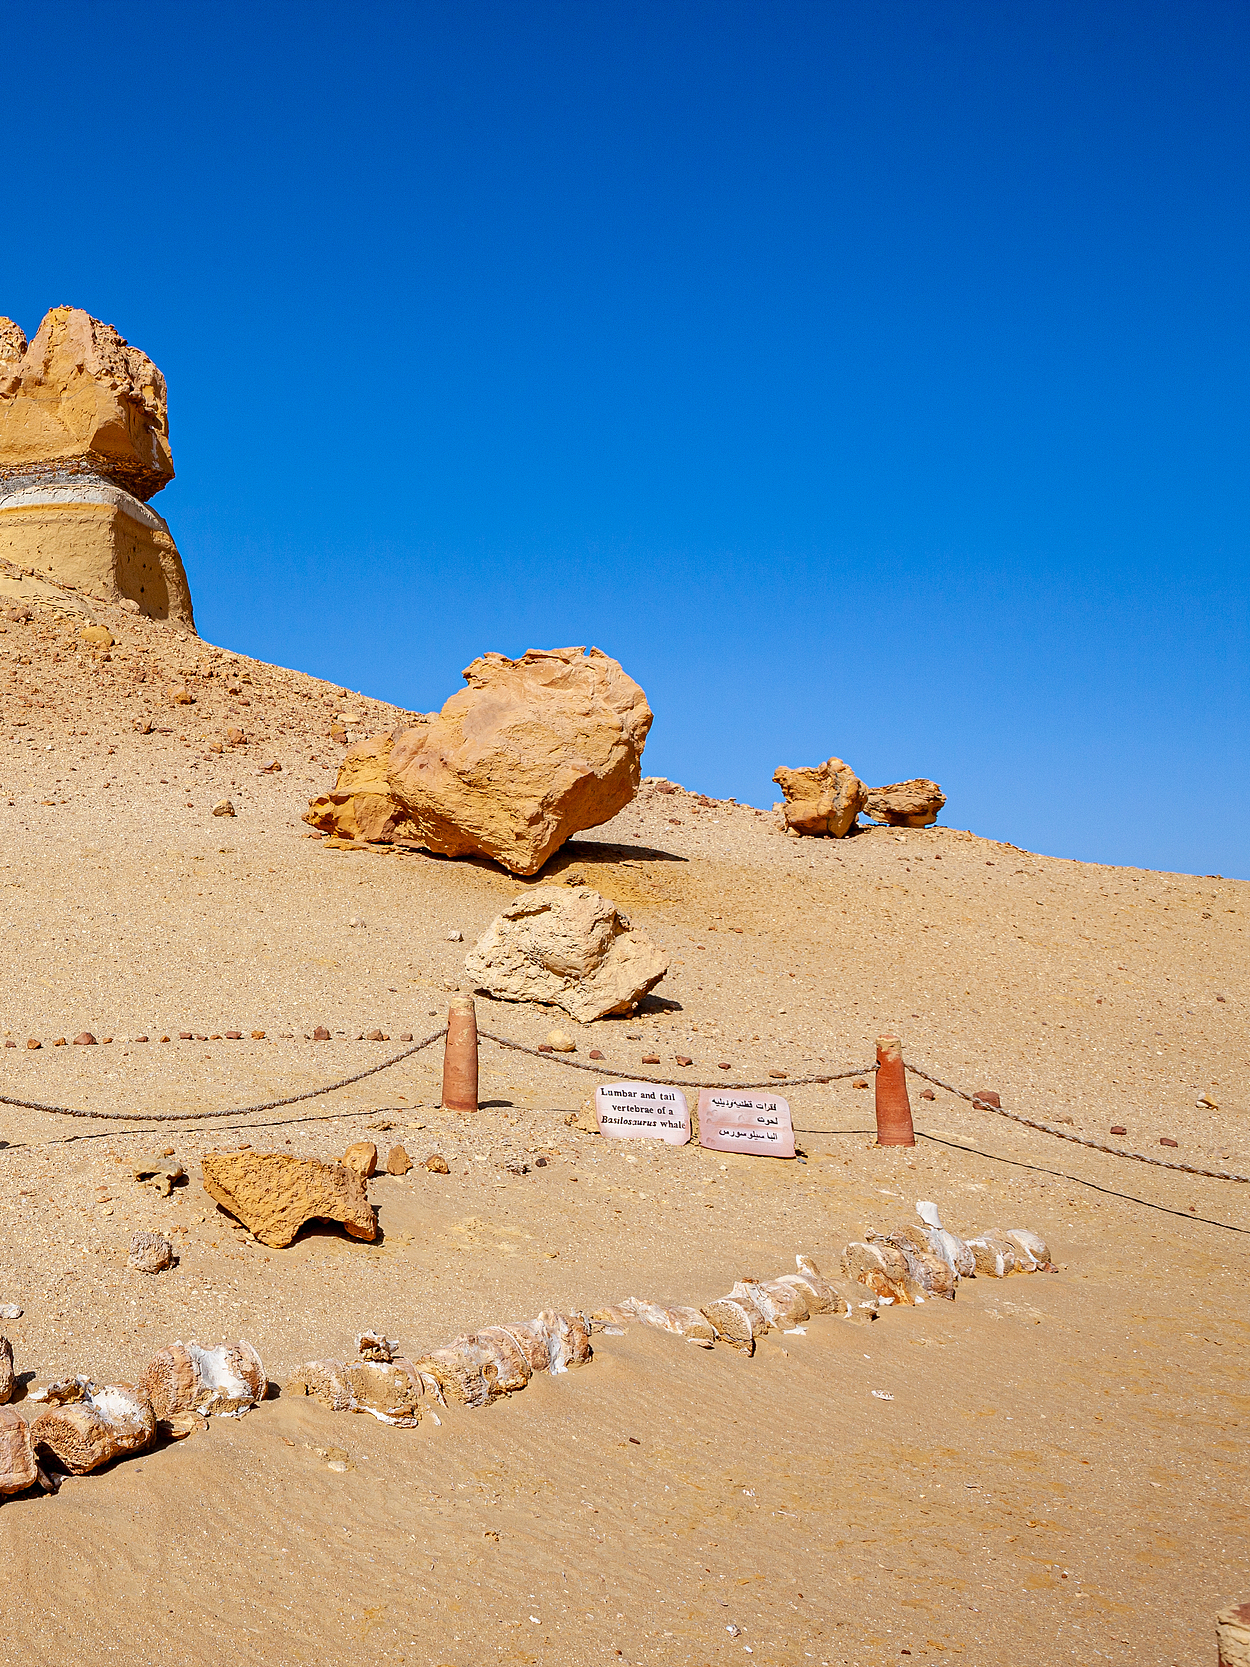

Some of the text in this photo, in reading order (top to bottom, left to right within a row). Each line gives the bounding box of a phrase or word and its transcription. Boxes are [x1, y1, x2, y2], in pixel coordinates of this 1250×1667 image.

[600, 1087, 676, 1101] Lumbar and tail
[611, 1104, 654, 1114] vertebrae
[657, 1106, 667, 1115] of
[601, 1115, 686, 1129] Basilosaurus whale
[756, 1116, 778, 1125] لحوت
